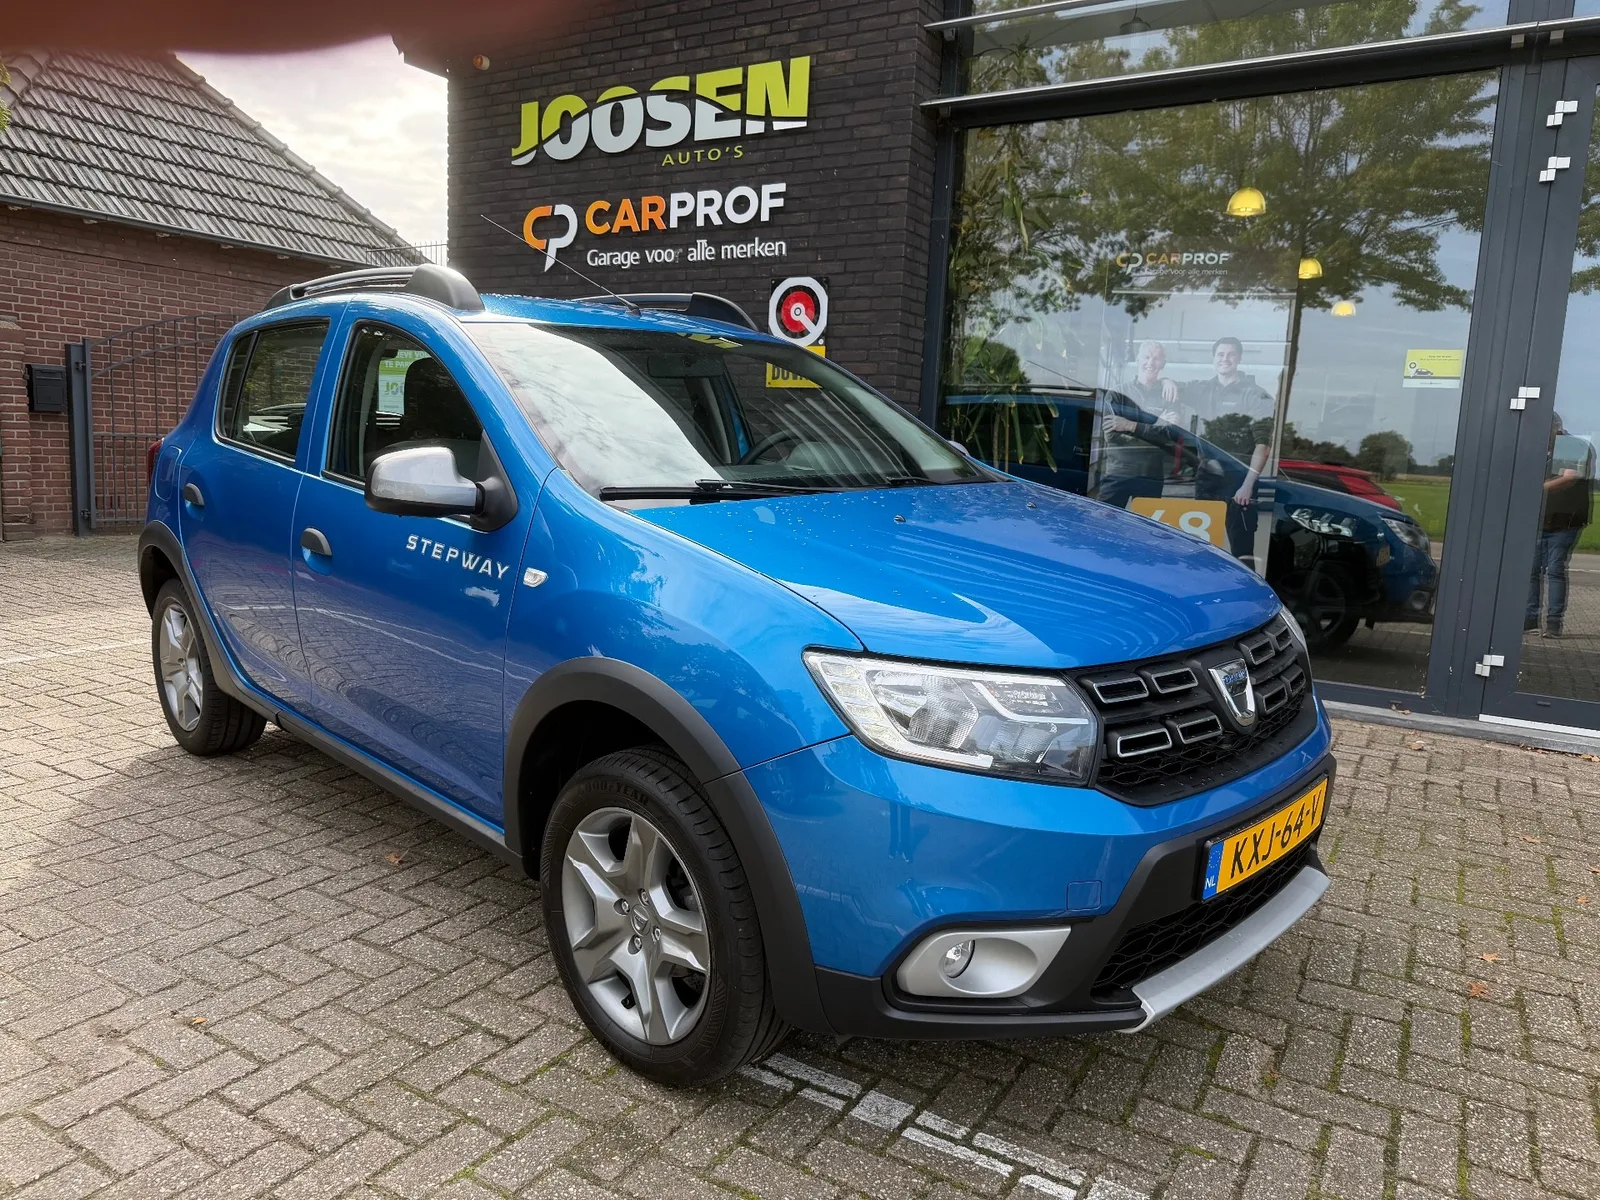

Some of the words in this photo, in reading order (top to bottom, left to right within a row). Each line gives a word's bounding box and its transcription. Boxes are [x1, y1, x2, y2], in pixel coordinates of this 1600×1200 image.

[511, 56, 811, 166] JOOSEN
[661, 145, 744, 167] AUTO'S
[585, 182, 787, 235] CARPROF
[586, 249, 640, 269] Garage
[721, 236, 787, 259] merken
[1146, 252, 1230, 266] CARPROF
[406, 534, 510, 579] STEPWAY
[1230, 788, 1322, 879] KXJ-64-V
[1204, 876, 1216, 889] NL
